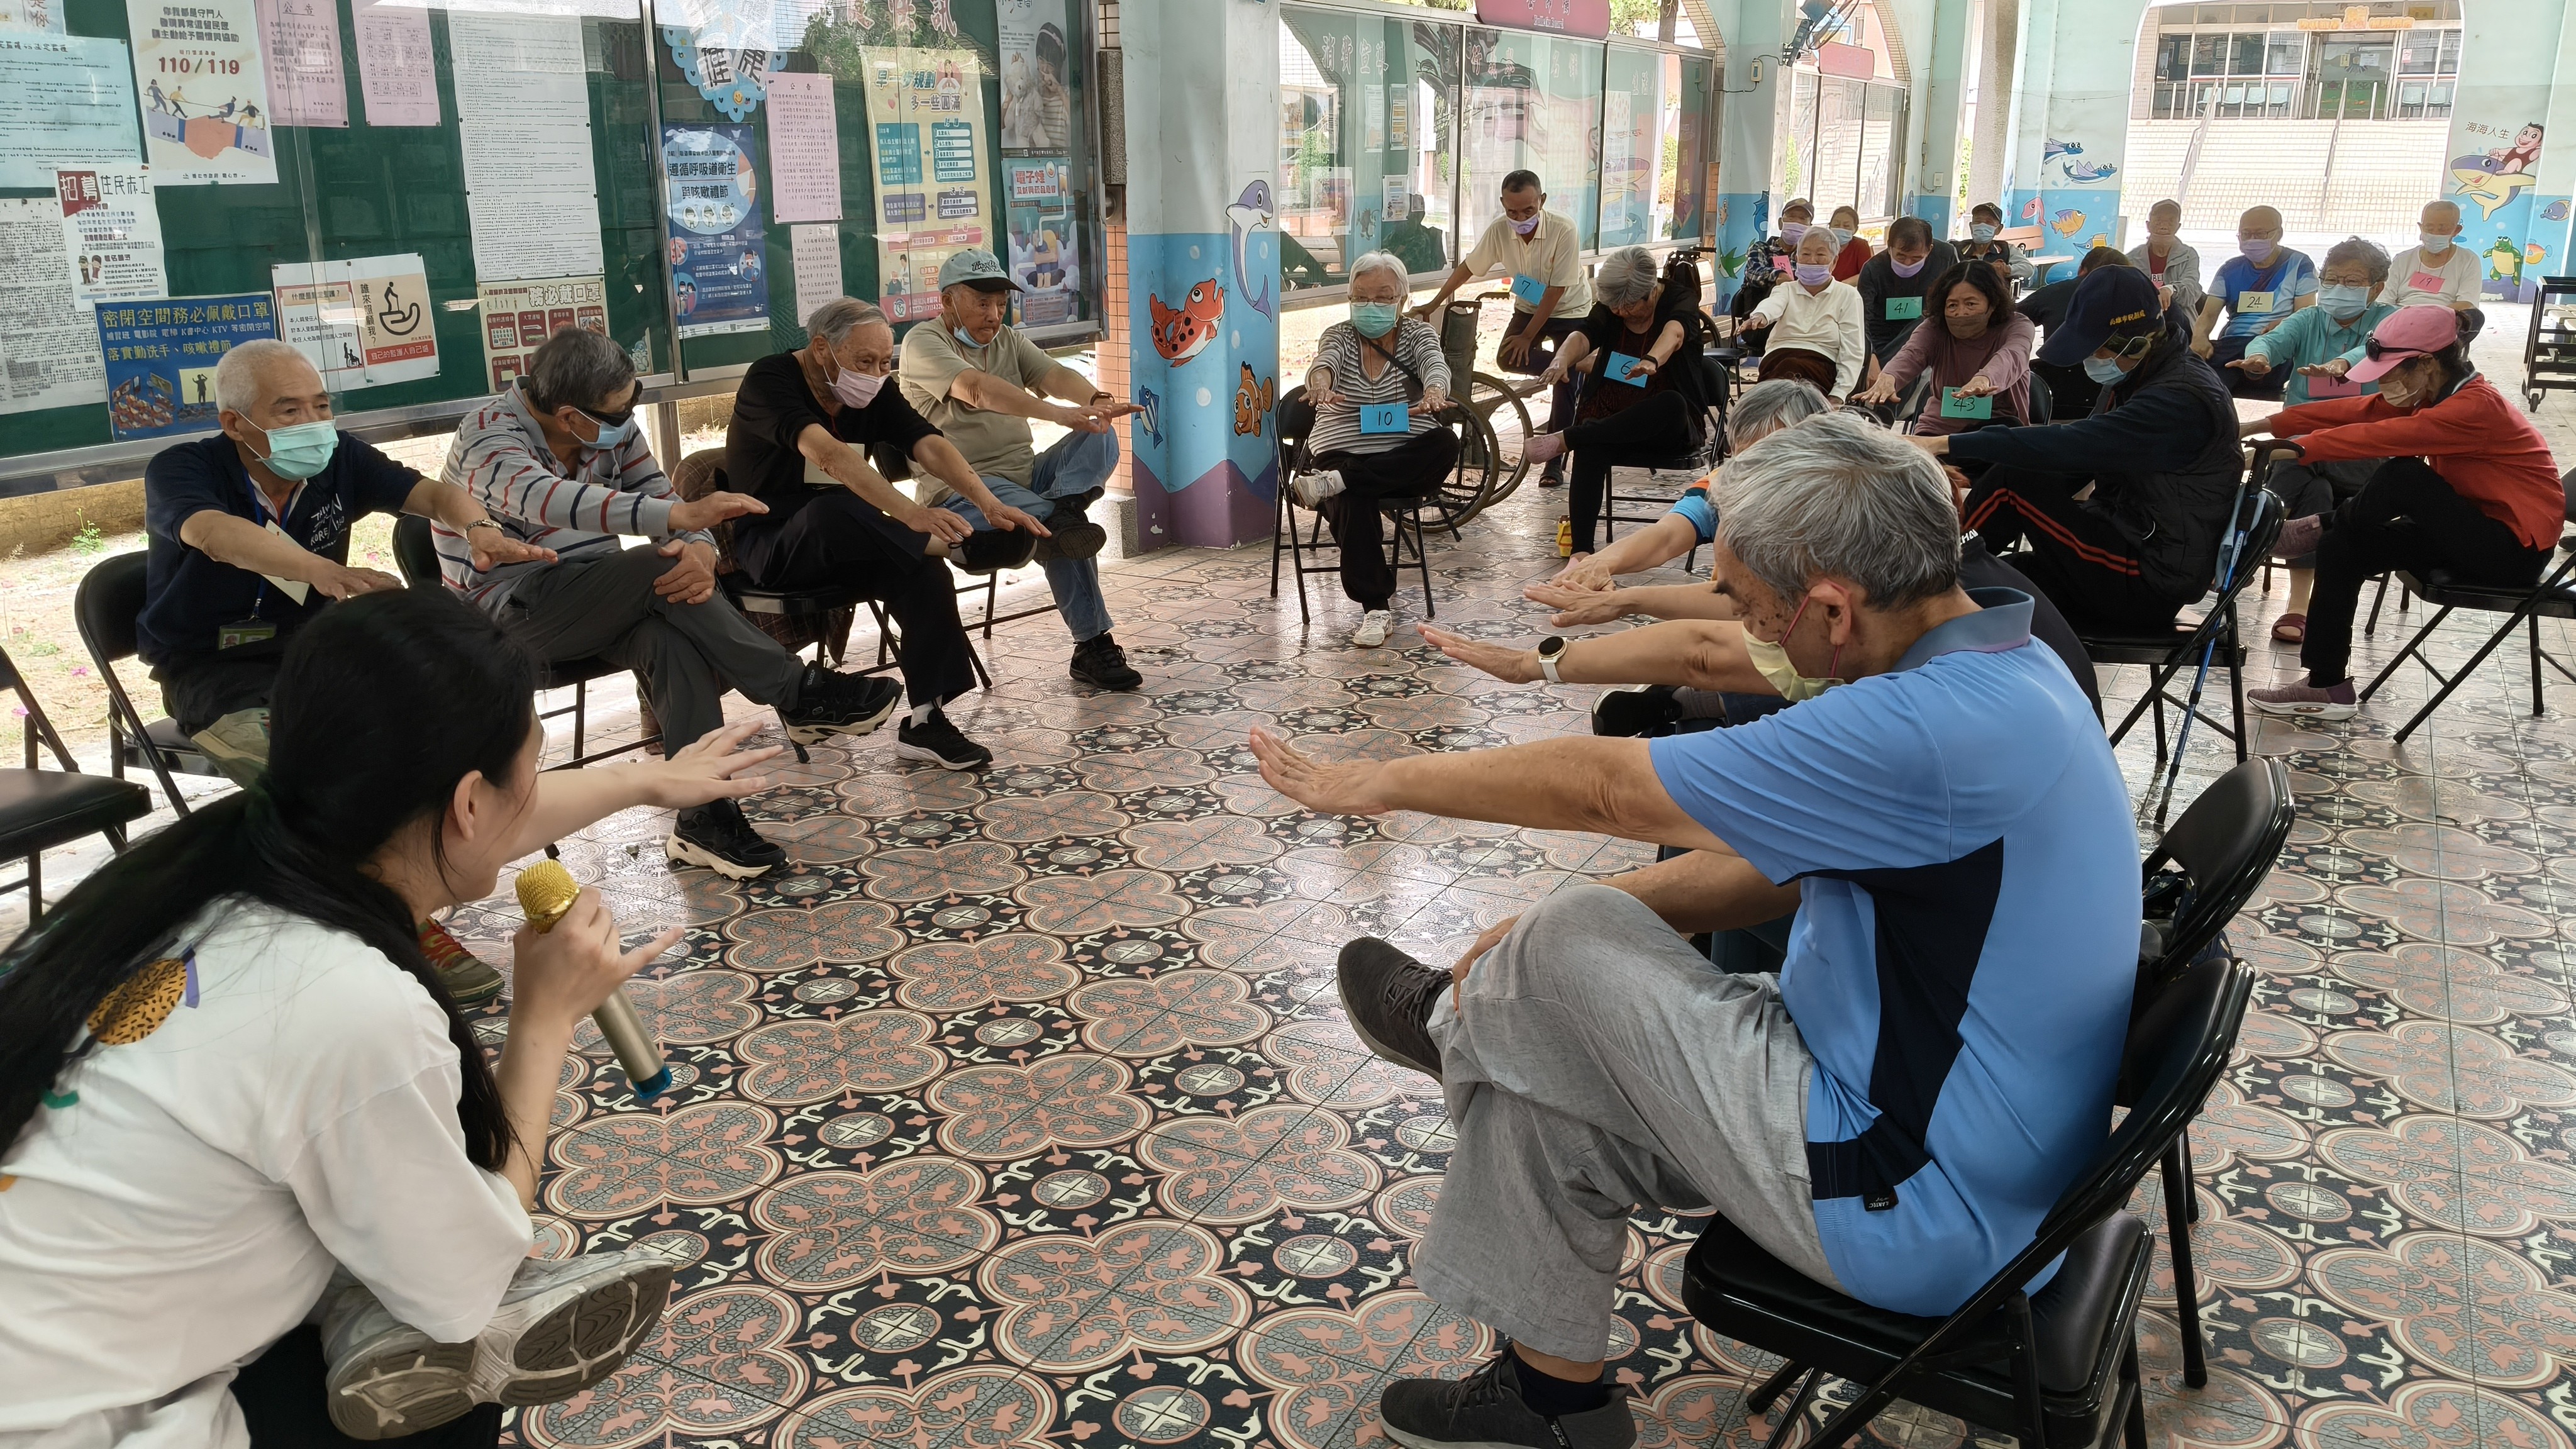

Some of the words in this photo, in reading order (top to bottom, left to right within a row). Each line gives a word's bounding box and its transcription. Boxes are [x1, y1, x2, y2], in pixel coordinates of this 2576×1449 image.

[284, 3, 314, 14] 公告
[875, 68, 936, 89] 早一步規劃
[911, 94, 961, 112] 多一些圓滿
[2465, 121, 2509, 139] 海海人生
[669, 162, 736, 176] 遵循呼吸道衛生
[682, 185, 728, 199] 與咳嗽禮節
[1522, 280, 1531, 295] 7
[2419, 277, 2432, 287] 19
[528, 282, 601, 307] 務必戴口罩
[2246, 296, 2263, 308] 24
[103, 302, 269, 328] 密閉空間務必佩戴口罩
[1894, 303, 1909, 314] 41
[212, 325, 228, 333] KTV
[1621, 360, 1633, 375] 6
[1953, 397, 1975, 412] 43
[1378, 411, 1392, 426] 10
